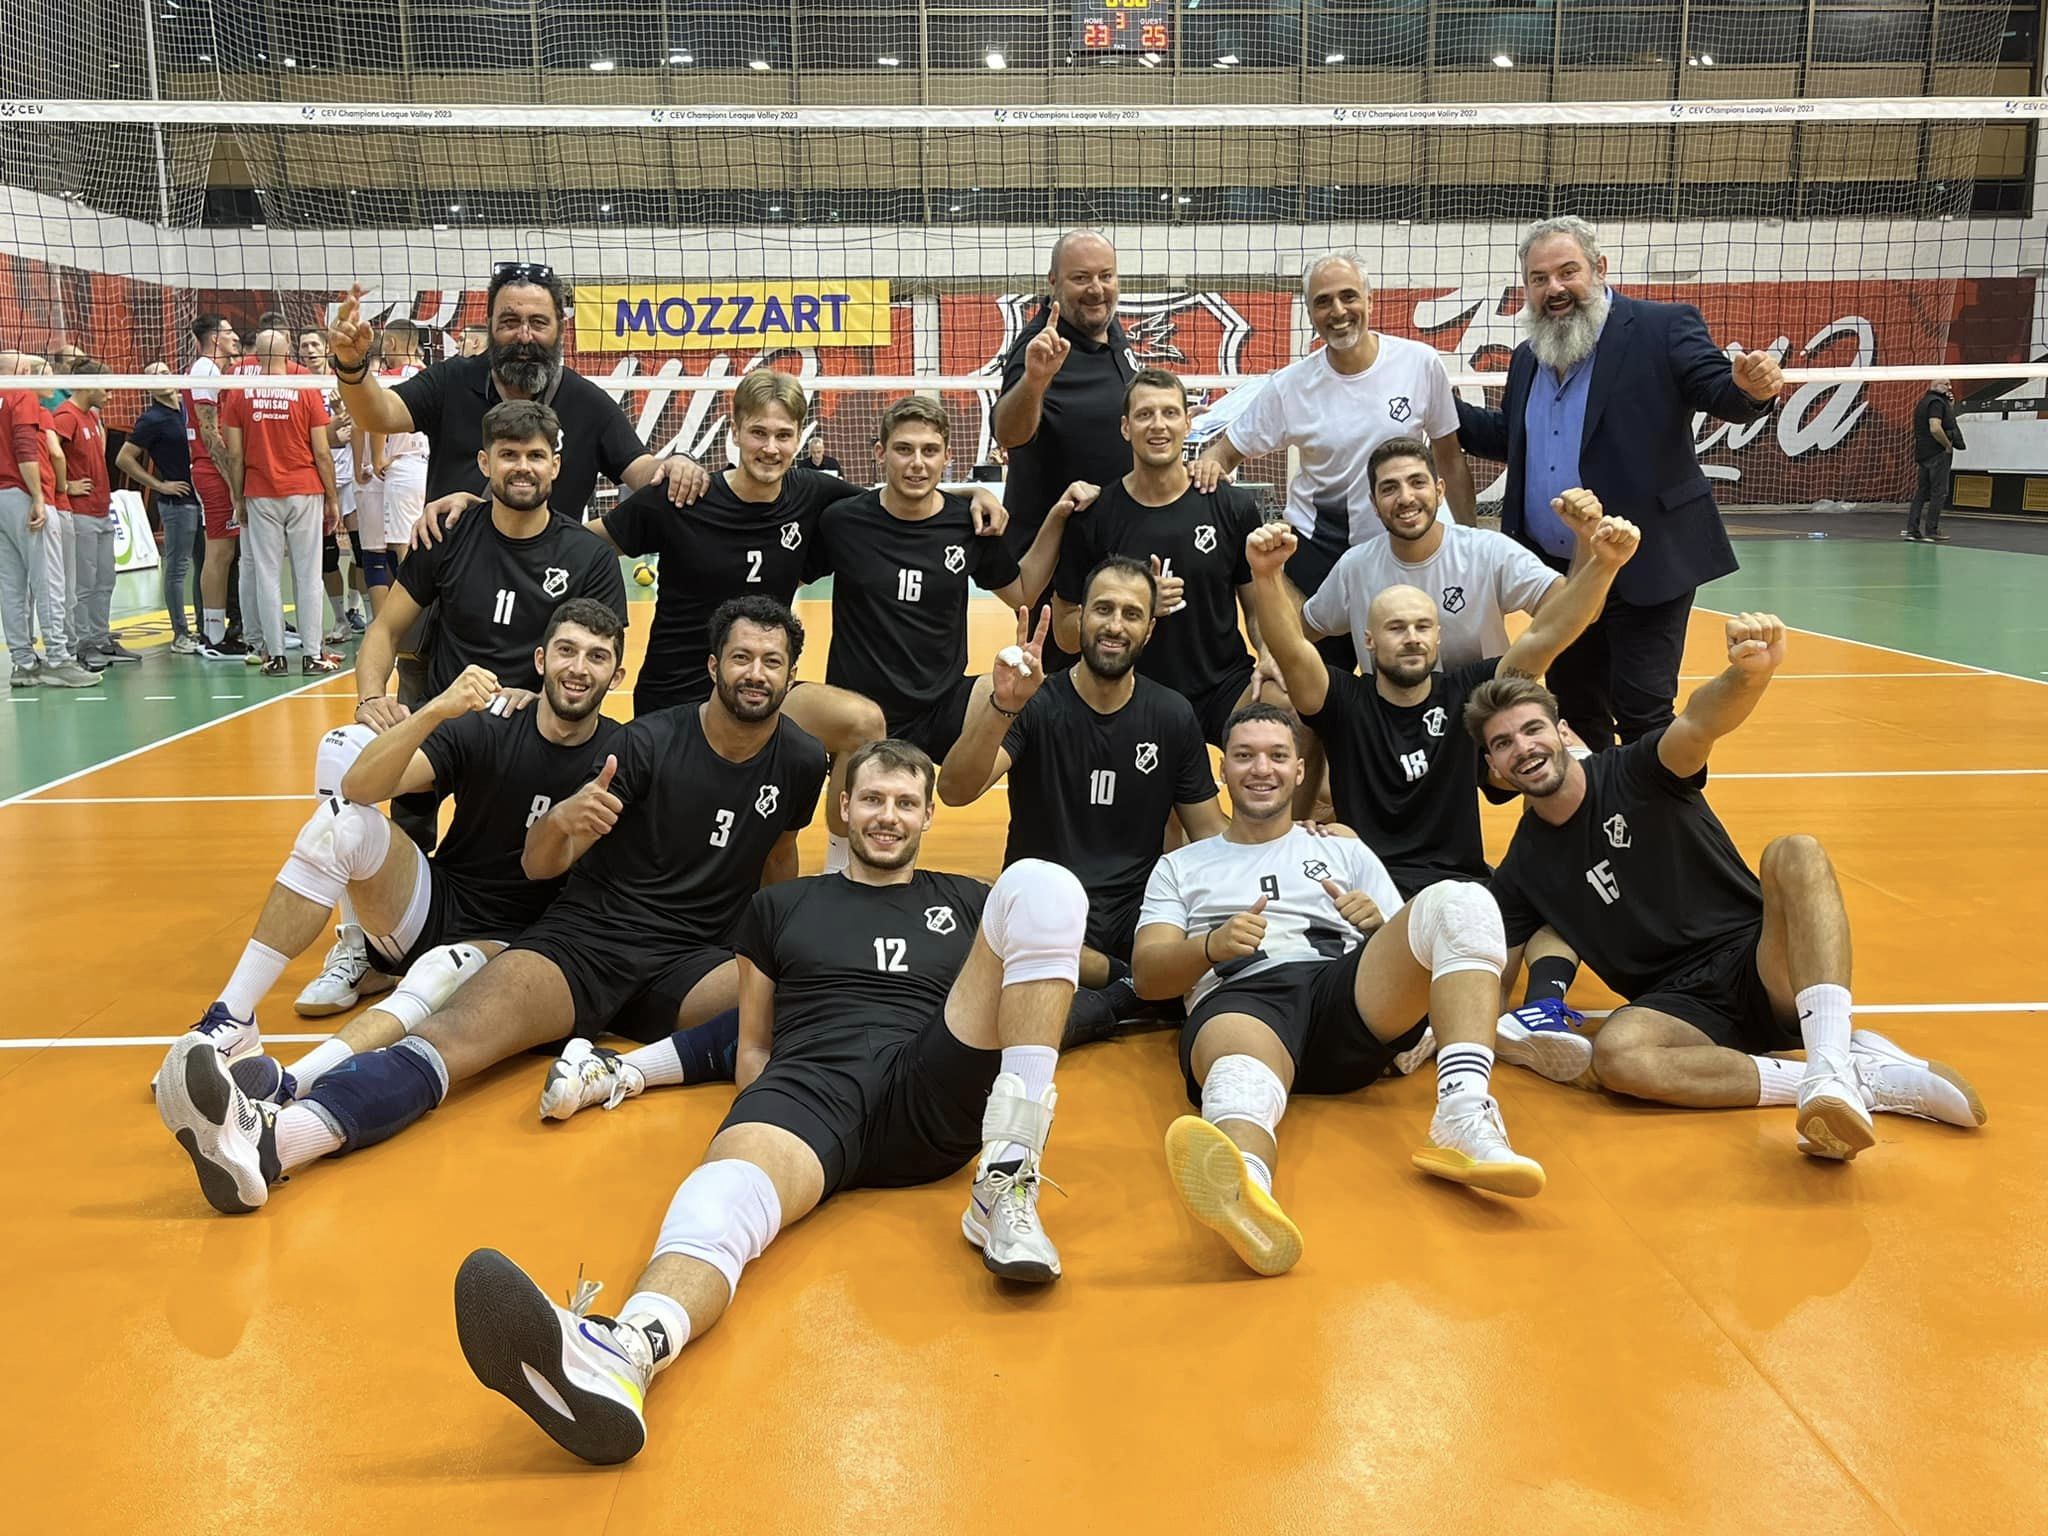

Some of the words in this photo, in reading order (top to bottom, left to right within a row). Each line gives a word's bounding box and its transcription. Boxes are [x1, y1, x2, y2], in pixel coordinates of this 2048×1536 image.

[1115, 11, 1126, 29] 3
[1084, 25, 1109, 46] 23
[1142, 25, 1166, 46] 25
[18, 105, 43, 114] CEV
[321, 109, 337, 117] CEV
[338, 109, 380, 120] Champions
[381, 110, 409, 120] League
[410, 110, 433, 120] Volley
[670, 111, 685, 119] CEV
[686, 111, 727, 121] Champions
[728, 111, 756, 121] League
[757, 111, 779, 120] Volley
[780, 111, 798, 119] 2023
[1012, 111, 1028, 119] CEV
[1029, 111, 1070, 121] Champions
[1071, 111, 1098, 121] League
[1099, 111, 1121, 121] Volley
[1122, 111, 1140, 119] 2023
[1351, 110, 1367, 118] CEV
[1368, 110, 1408, 120] Champions
[1409, 110, 1436, 120] League
[1437, 109, 1459, 119] Volley
[1460, 109, 1477, 118] 2023
[1689, 106, 1703, 114] CEV
[1705, 105, 1745, 115] Champions
[1746, 105, 1773, 115] League
[1774, 105, 1796, 114] Volley
[1797, 105, 1815, 113] 2023
[614, 293, 850, 338] MOZZART
[252, 399, 272, 409] NOVI
[272, 400, 289, 410] SAD
[746, 550, 763, 583] 2
[897, 568, 923, 602] 16
[493, 588, 516, 625] 11
[1399, 748, 1429, 782] 18
[1090, 769, 1116, 805] 10
[709, 808, 735, 848] 3
[1260, 874, 1280, 901] 9
[1585, 859, 1621, 905] 15
[873, 937, 909, 973] 12
